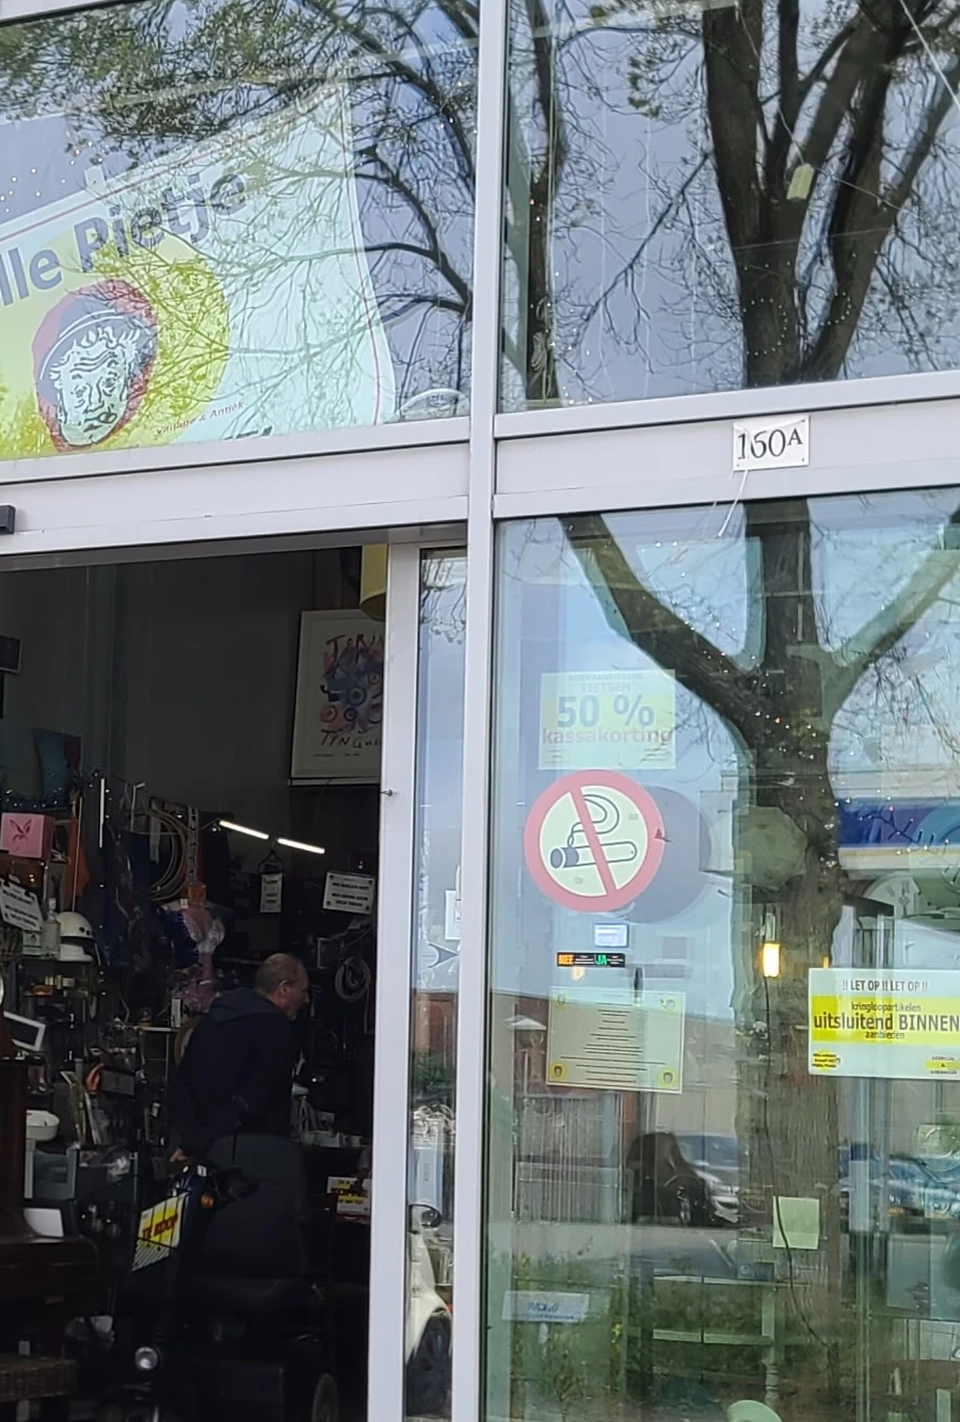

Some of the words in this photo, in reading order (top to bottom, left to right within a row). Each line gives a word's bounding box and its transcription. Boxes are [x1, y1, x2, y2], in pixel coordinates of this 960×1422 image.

[73, 173, 247, 274] Pietje
[557, 695, 600, 728] 50
[613, 694, 655, 728] %
[850, 980, 866, 991] LET
[867, 980, 880, 991] OP
[890, 980, 905, 992] LET
[907, 981, 920, 992] OP
[813, 1011, 894, 1031] uitsluitend
[898, 1014, 960, 1032] BINNEN
